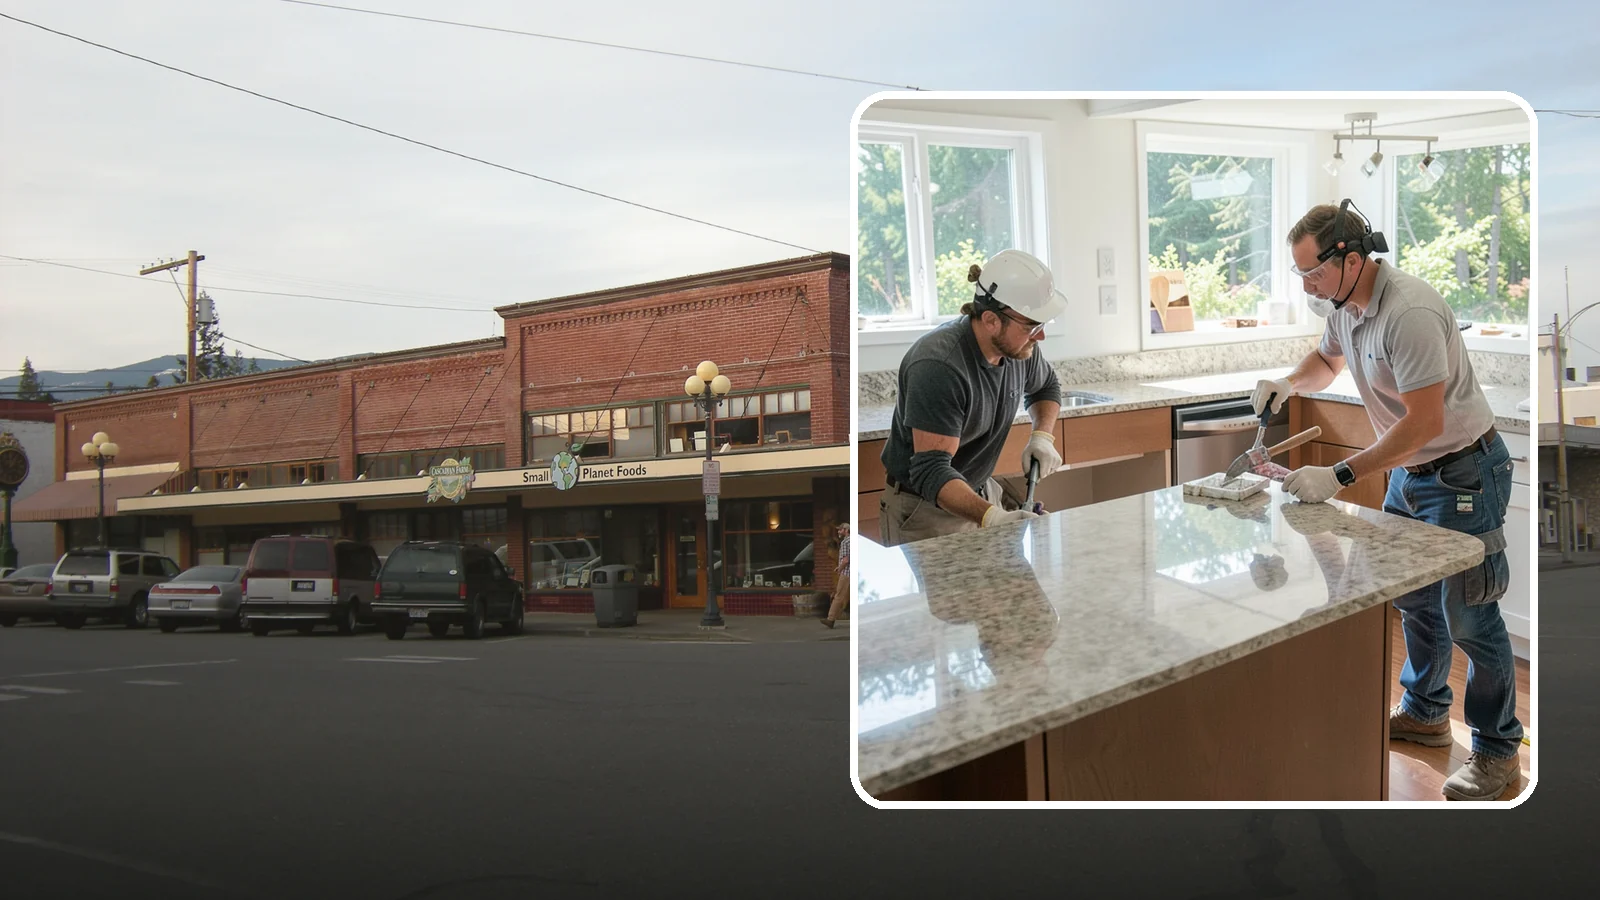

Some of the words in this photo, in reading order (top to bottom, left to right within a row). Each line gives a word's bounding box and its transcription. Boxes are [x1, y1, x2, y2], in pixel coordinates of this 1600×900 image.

[523, 471, 549, 483] Small
[583, 467, 614, 479] Planet
[617, 464, 647, 477] Foods
